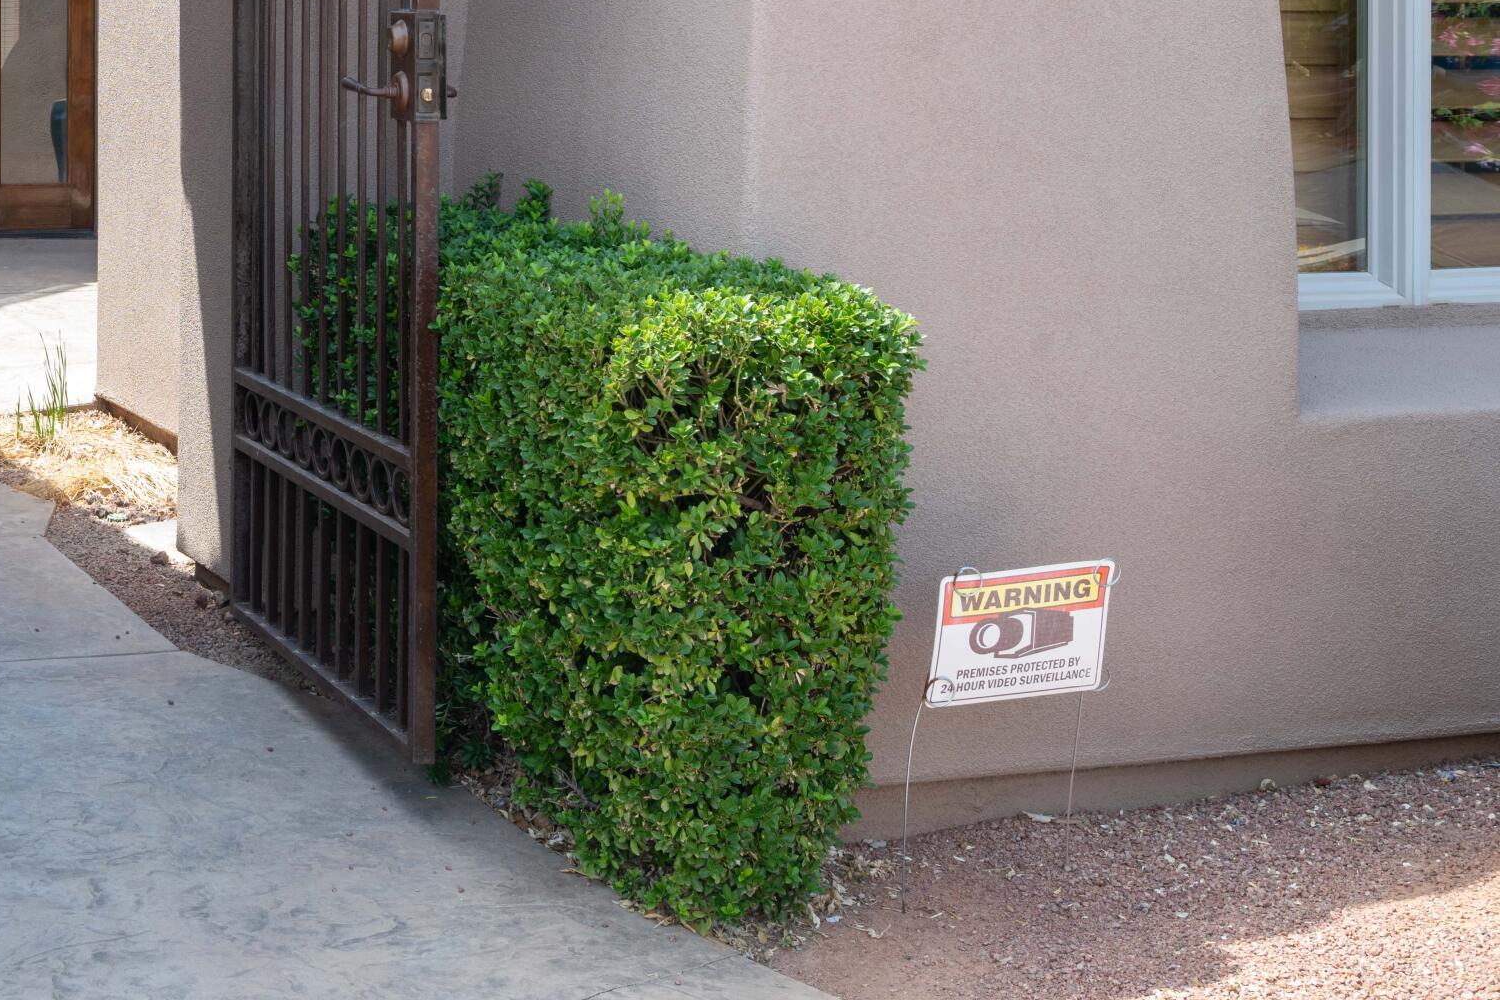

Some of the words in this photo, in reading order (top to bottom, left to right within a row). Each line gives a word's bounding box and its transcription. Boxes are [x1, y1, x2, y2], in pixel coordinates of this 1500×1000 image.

[960, 579, 1091, 612] WARNING
[940, 684, 954, 694] 24
[956, 680, 985, 692] HOUR
[988, 676, 1017, 689] VIDEO
[1019, 668, 1091, 686] SURVEILLANCE
[956, 665, 1008, 680] PREMISES
[1010, 660, 1066, 674] PROTECTED
[1068, 656, 1081, 667] BY
